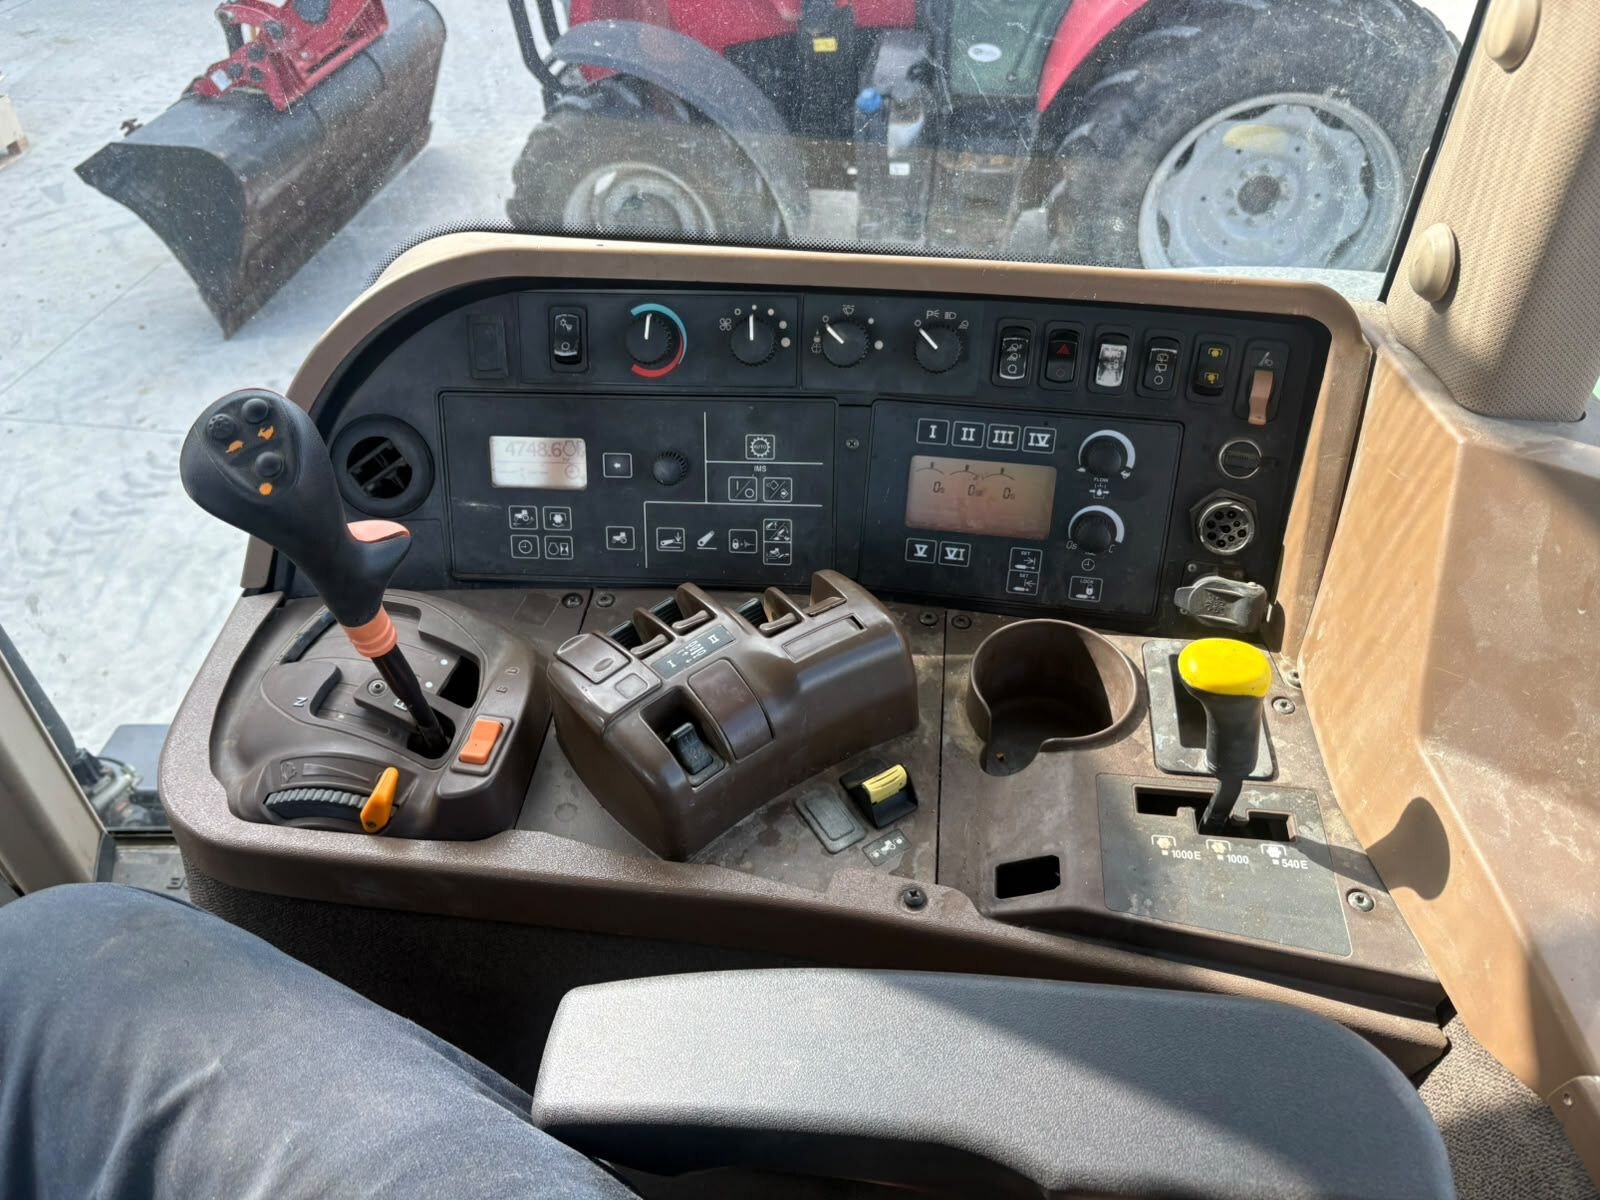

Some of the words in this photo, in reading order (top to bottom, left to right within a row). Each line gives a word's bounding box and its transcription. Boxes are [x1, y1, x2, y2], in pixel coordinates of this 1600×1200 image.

[960, 427, 977, 442] II
[992, 429, 1015, 445] III
[1027, 432, 1051, 448] IV
[505, 439, 562, 458] 4748.6
[753, 464, 767, 473] IMS
[913, 543, 929, 558] V
[944, 546, 966, 561] VI
[1226, 853, 1250, 865] 1000
